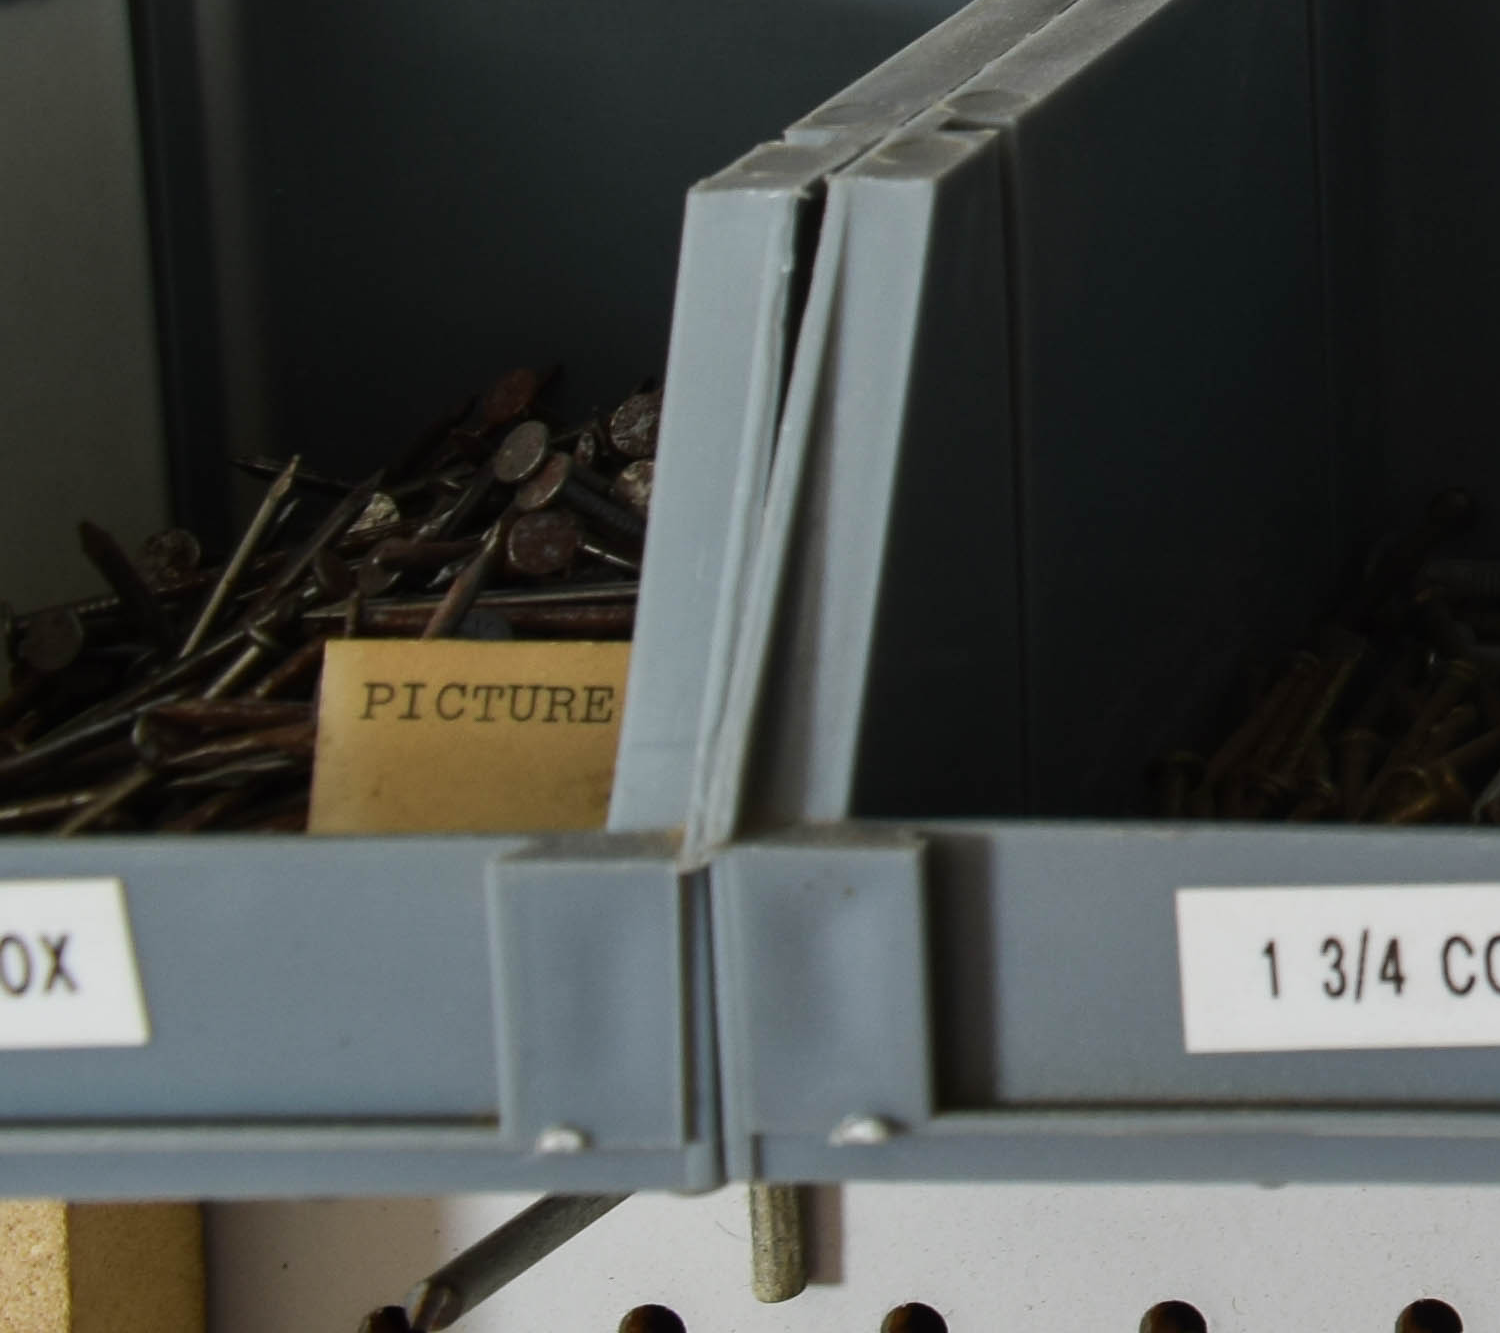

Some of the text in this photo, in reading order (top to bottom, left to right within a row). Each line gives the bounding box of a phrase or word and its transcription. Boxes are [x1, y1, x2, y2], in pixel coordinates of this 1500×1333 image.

[359, 681, 616, 724] PICTURE
[1261, 940, 1280, 999] 1
[1320, 929, 1406, 1002] 3/4
